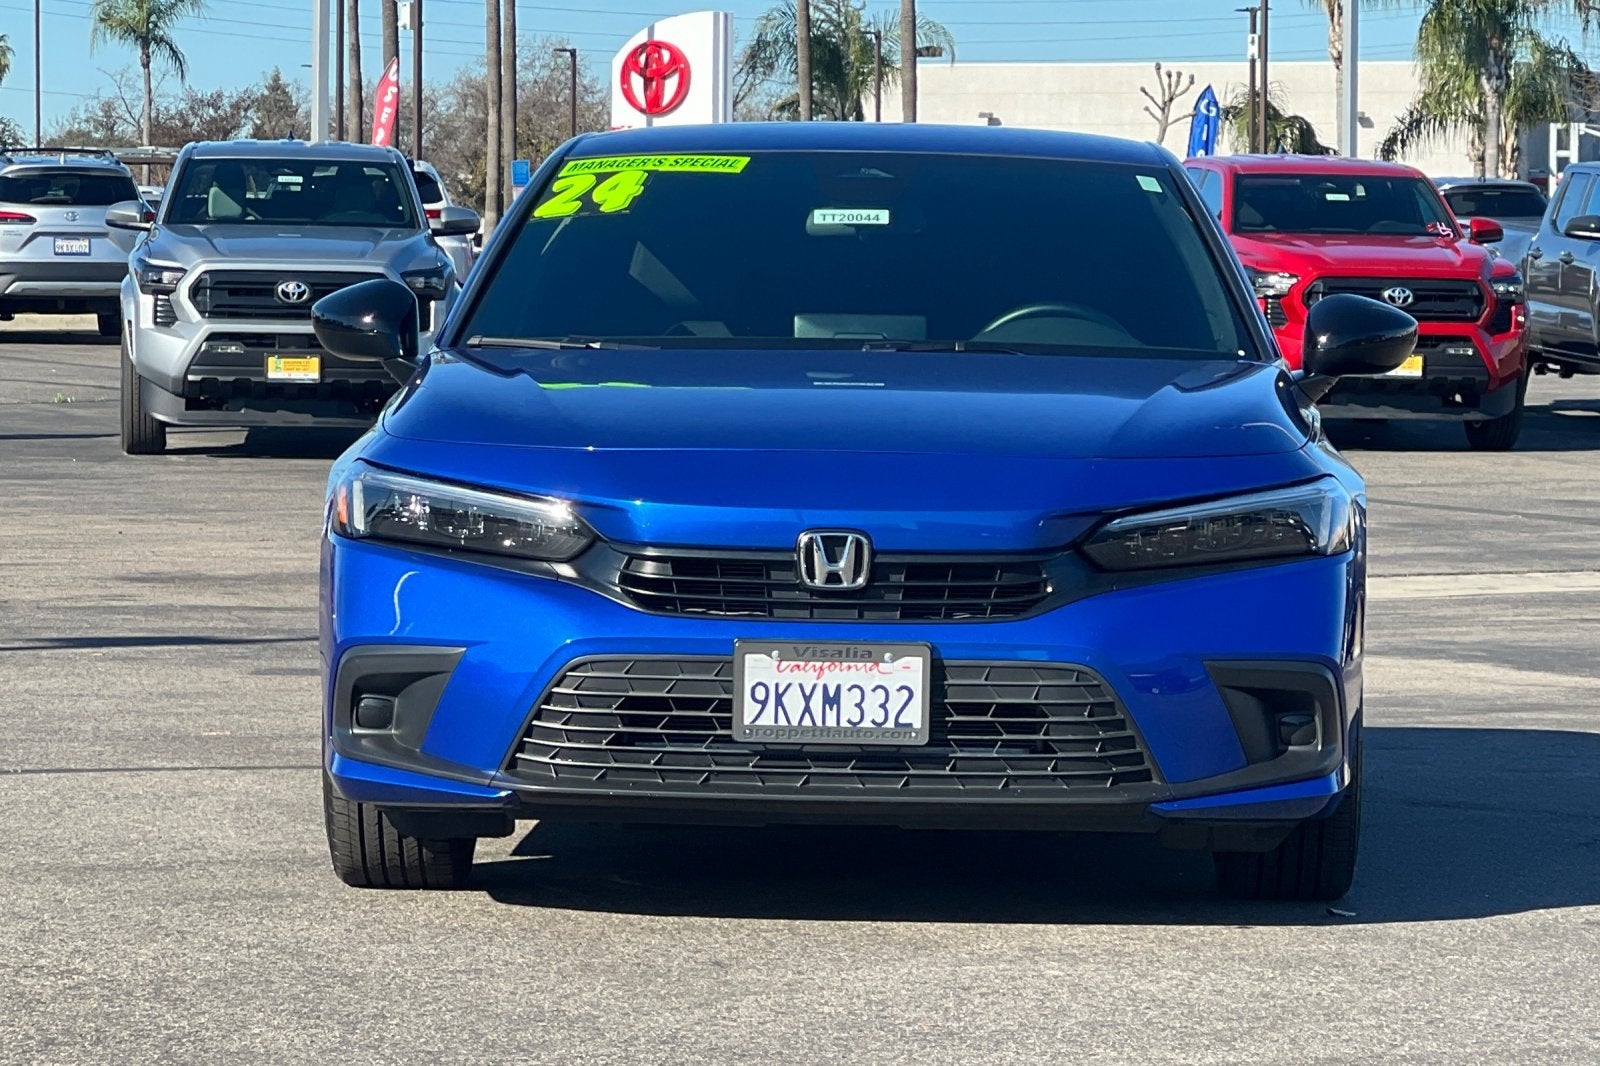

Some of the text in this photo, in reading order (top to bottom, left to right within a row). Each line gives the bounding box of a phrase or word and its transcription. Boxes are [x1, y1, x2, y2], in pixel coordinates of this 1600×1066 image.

[567, 156, 739, 172] MANAGER'S SPECIAL
[533, 169, 648, 218] 24
[820, 213, 880, 222] TT20044
[793, 646, 873, 659] Visalia
[776, 659, 893, 680] California
[750, 681, 915, 728] 9KXM332
[742, 727, 920, 740] groppettiauto.com
